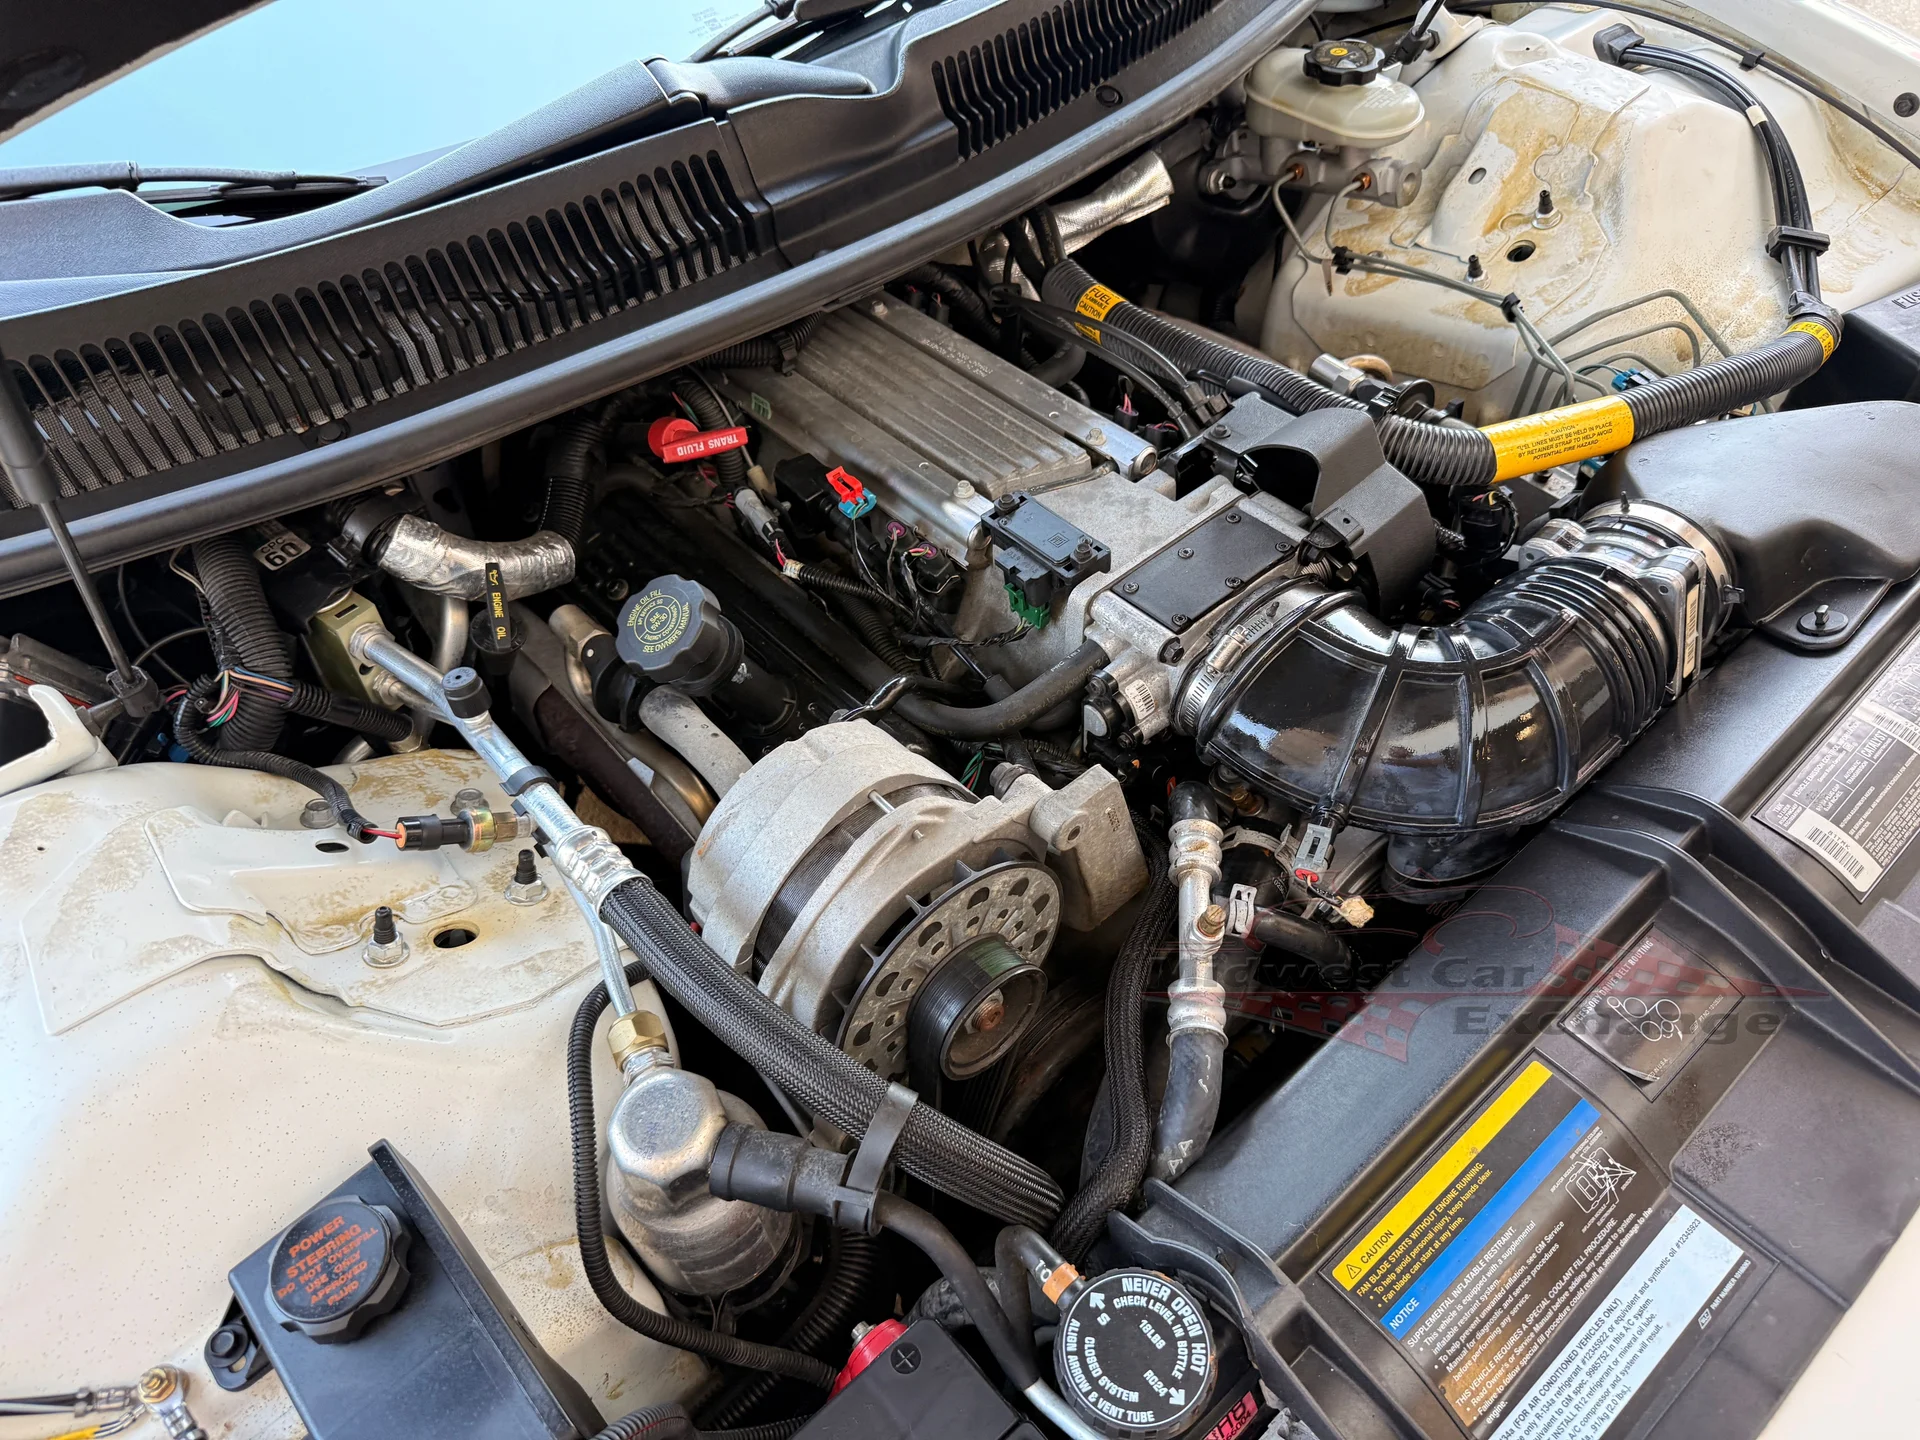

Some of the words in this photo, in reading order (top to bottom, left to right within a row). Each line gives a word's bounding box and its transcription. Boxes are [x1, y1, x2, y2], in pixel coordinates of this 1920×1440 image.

[1078, 300, 1102, 319] CAUTION
[1089, 288, 1112, 305] FUEL
[708, 434, 738, 449] TRANS
[1527, 444, 1554, 456] RETAINER
[1555, 440, 1572, 448] STRAP
[1582, 432, 1596, 440] HELP
[1596, 428, 1612, 437] AVOID
[1532, 438, 1548, 448] LINES
[1548, 435, 1564, 444] MUST
[1574, 428, 1588, 436] HELD
[1595, 422, 1612, 430] PLACE
[1551, 424, 1575, 434] CAUTION
[676, 442, 704, 456] FLUID
[1532, 449, 1562, 460] POTENTIAL
[1576, 439, 1598, 449] HAZARD
[260, 537, 286, 554] CPC
[265, 542, 302, 566] 60
[492, 592, 504, 618] ENGINE
[627, 603, 642, 627] ENGINE
[640, 595, 650, 605] OIL
[650, 588, 662, 598] FILL
[650, 612, 660, 624] SAE
[651, 612, 668, 631] 5W-30
[496, 626, 506, 640] OIL
[642, 645, 654, 653] SEE
[654, 630, 682, 652] OWNER'S
[680, 602, 690, 630] MANUAL
[1860, 729, 1887, 758] CATALYST
[1791, 778, 1809, 798] VEHICLE
[1806, 760, 1825, 781] EMISSION
[1569, 991, 1603, 1028] ACCESSORY
[1598, 975, 1618, 996] DRIVE
[1614, 962, 1631, 980] BELT
[1627, 938, 1653, 966] ROUTING
[289, 1216, 345, 1258] POWER
[1356, 1280, 1371, 1297] FAN
[1368, 1259, 1391, 1284] BLADE
[1387, 1236, 1412, 1263] STARTS
[1409, 1209, 1437, 1240] WITHOUT
[1435, 1187, 1458, 1213] ENGINE
[1455, 1160, 1484, 1191] RUNNING.
[1373, 1283, 1384, 1295] To
[1380, 1270, 1397, 1288] help
[1393, 1254, 1411, 1274] avoid
[1408, 1229, 1435, 1259] personal
[1431, 1212, 1451, 1234] injury,
[1446, 1198, 1464, 1217] keep
[1459, 1181, 1479, 1202] hands
[1475, 1166, 1492, 1185] clear.
[277, 1282, 296, 1298] DO
[300, 1264, 322, 1284] NOT
[328, 1228, 378, 1264] OVERFILL
[286, 1224, 361, 1278] STEERING
[1359, 1228, 1393, 1265] CAUTION
[1381, 1287, 1396, 1303] Fan
[1392, 1270, 1411, 1291] blade
[1409, 1260, 1422, 1274] can
[1419, 1245, 1435, 1263] start
[1431, 1238, 1441, 1249] at
[1439, 1229, 1452, 1243] any
[1447, 1213, 1464, 1231] time.
[306, 1273, 329, 1293] USE
[334, 1250, 360, 1274] ONLY
[311, 1260, 368, 1304] APPROVED
[1406, 1294, 1454, 1348] SUPPLEMENTAL
[1451, 1259, 1486, 1298] INFLATABLE
[1483, 1225, 1516, 1262] RESTRAINT.
[327, 1280, 359, 1306] FLUID
[1112, 1295, 1148, 1310] CHECK
[1438, 1352, 1448, 1364] To
[1445, 1338, 1462, 1357] help
[1457, 1315, 1482, 1343] prevent
[1477, 1286, 1506, 1319] unwanted
[1503, 1262, 1528, 1290] inflation,
[1525, 1252, 1537, 1265] see
[1534, 1240, 1546, 1254] GM
[1543, 1219, 1564, 1243] Service
[1445, 1346, 1468, 1373] Manual
[1465, 1336, 1478, 1351] for
[1473, 1306, 1504, 1341] diagnostic
[1500, 1293, 1514, 1309] and
[1511, 1273, 1532, 1297] service
[1528, 1241, 1560, 1277] procedures
[1709, 1295, 1722, 1310] PART
[1718, 1276, 1737, 1299] NUMBER
[1096, 1312, 1112, 1326] S
[1122, 1278, 1172, 1301] NEVER
[1170, 1297, 1203, 1338] OPEN
[1190, 1342, 1206, 1376] HOT
[1148, 1300, 1174, 1325] LEVEL
[1389, 1296, 1419, 1330] NOTICE
[1431, 1323, 1459, 1355] inflatable
[1455, 1298, 1481, 1327] restraint
[1478, 1275, 1502, 1303] system.
[1455, 1388, 1471, 1407] THIS
[1469, 1360, 1495, 1391] VEHICLE
[1492, 1327, 1523, 1363] REQUIRES
[1520, 1322, 1528, 1331] A
[1525, 1296, 1550, 1325] SPECIAL
[1547, 1266, 1575, 1299] COOLANT
[1572, 1253, 1586, 1269] FILL
[1583, 1216, 1617, 1256] PROCEDURE.
[1522, 1417, 1539, 1438] only
[1534, 1395, 1556, 1421] R-134a
[1552, 1363, 1583, 1400] refrigerant
[1579, 1330, 1609, 1366] #12345922
[1607, 1323, 1615, 1334] or
[1612, 1292, 1641, 1327] equivalent
[1636, 1280, 1649, 1295] and
[1646, 1255, 1671, 1285] synthetic
[1667, 1246, 1677, 1258] oil
[1674, 1217, 1701, 1249] #12345923
[1066, 1318, 1081, 1352] ALIGN
[1172, 1324, 1186, 1338] IN
[1452, 1358, 1473, 1382] before
[1469, 1324, 1502, 1362] performing
[1499, 1314, 1512, 1329] any
[1508, 1290, 1531, 1317] service.
[1068, 1354, 1092, 1394] ARROW
[1084, 1336, 1102, 1378] CLOSED
[1098, 1376, 1140, 1403] SYSTEM
[1171, 1340, 1188, 1380] BOTTLE
[1512, 1407, 1531, 1430] (FOR
[1527, 1394, 1540, 1411] AIR
[1537, 1347, 1579, 1398] CONDITIONED
[1575, 1316, 1605, 1352] VEHICLES
[1602, 1296, 1622, 1320] ONLY)
[1088, 1390, 1098, 1403] &
[1142, 1369, 1169, 1398] RC24
[1096, 1398, 1125, 1418] VENT
[1126, 1410, 1156, 1423] TUBE
[1485, 1397, 1509, 1426] engine.
